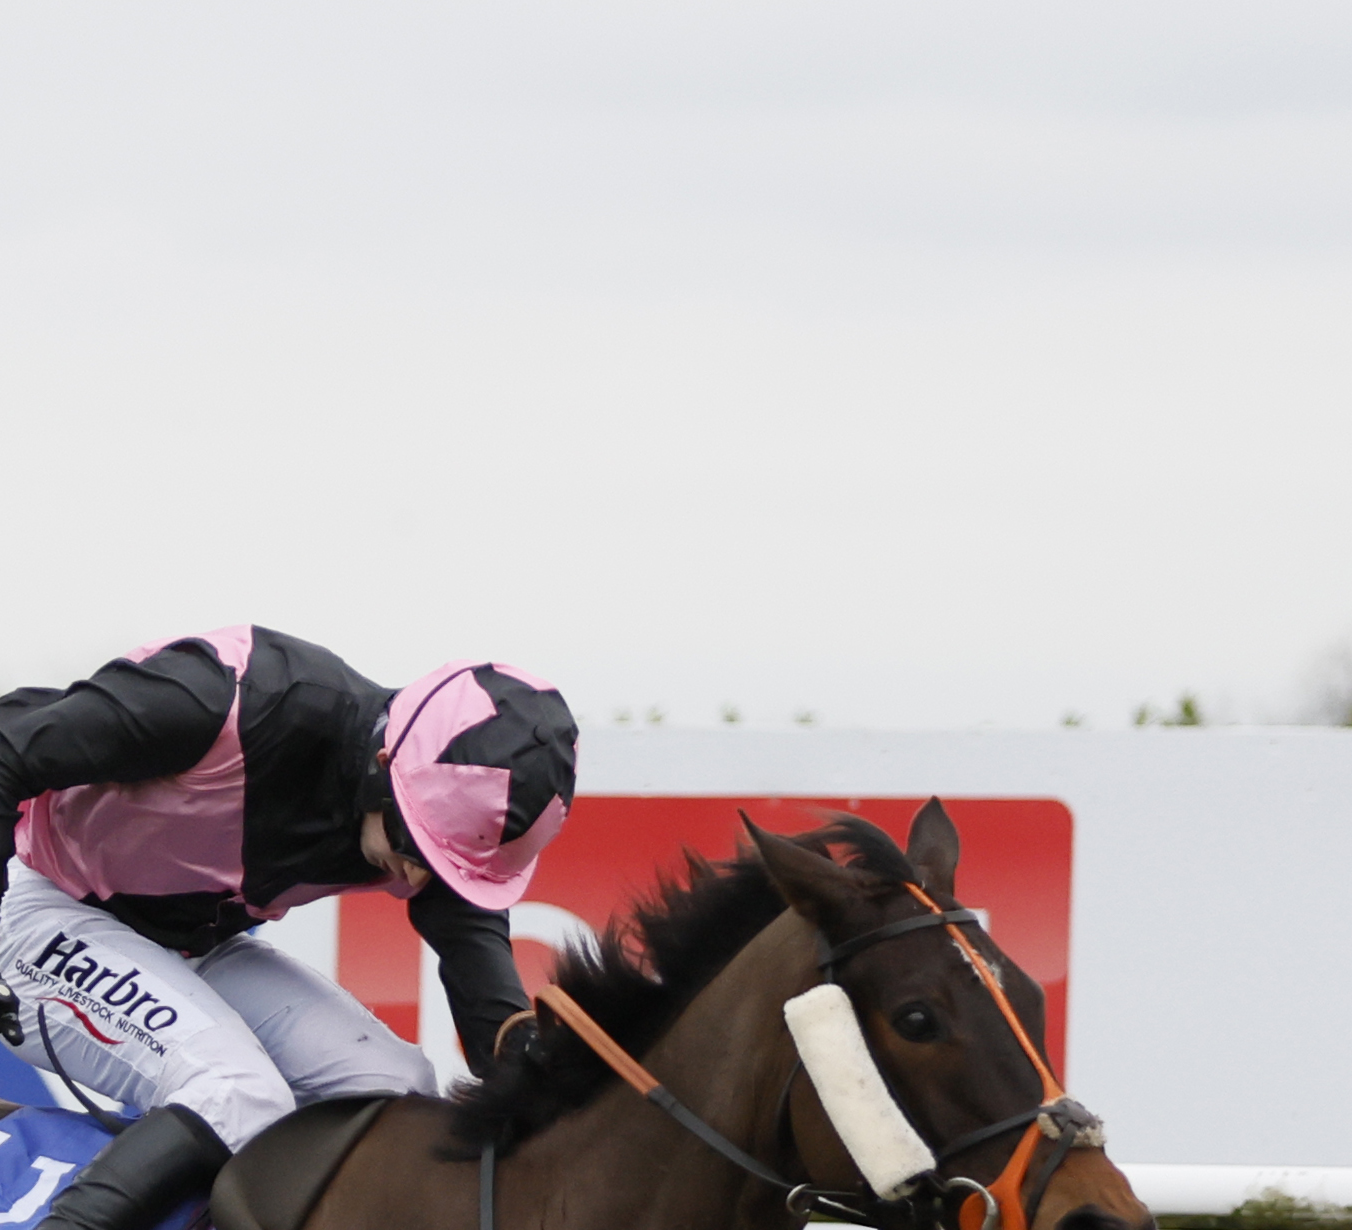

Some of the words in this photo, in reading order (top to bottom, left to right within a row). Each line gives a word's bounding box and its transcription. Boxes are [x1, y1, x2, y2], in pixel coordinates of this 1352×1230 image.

[15, 959, 59, 988] QUALITY
[57, 984, 115, 1024] LIVESTOCK
[115, 1016, 168, 1058] NUTRITION
[32, 930, 178, 1033] Harbro
